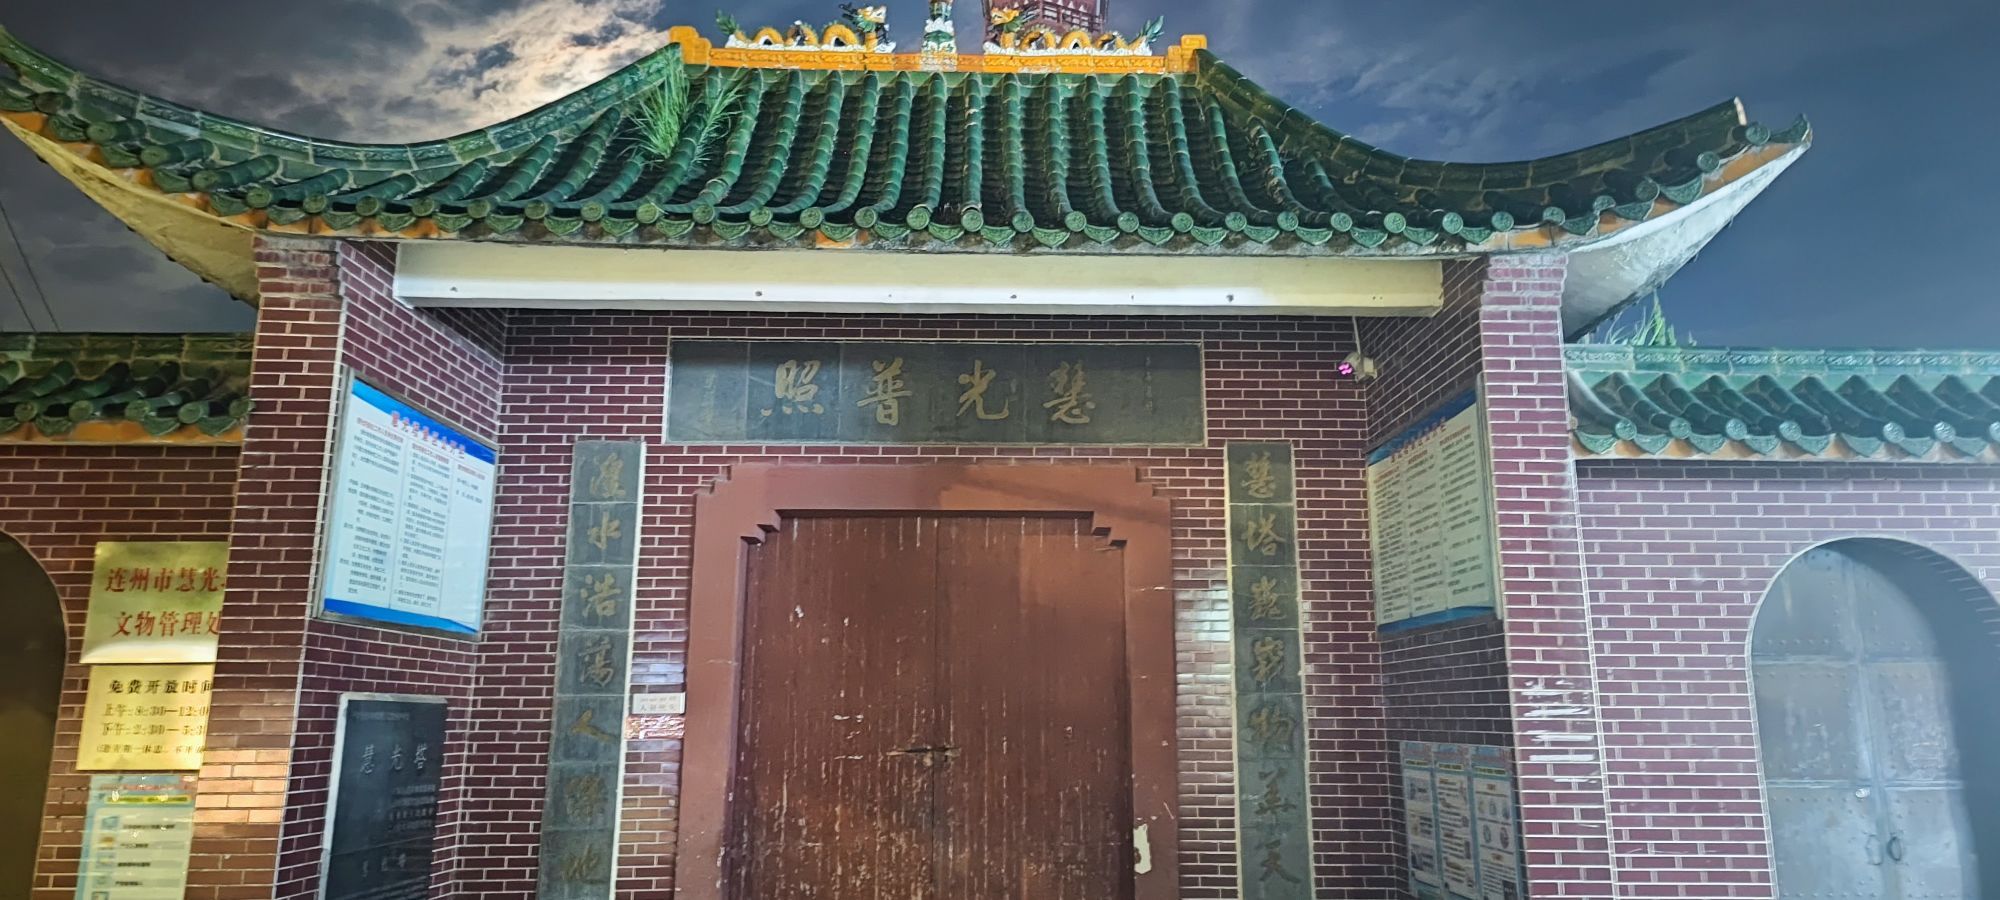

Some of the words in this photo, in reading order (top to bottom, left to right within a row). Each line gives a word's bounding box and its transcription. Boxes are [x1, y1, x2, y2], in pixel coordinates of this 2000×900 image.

[105, 567, 224, 592] 连州市慧光
